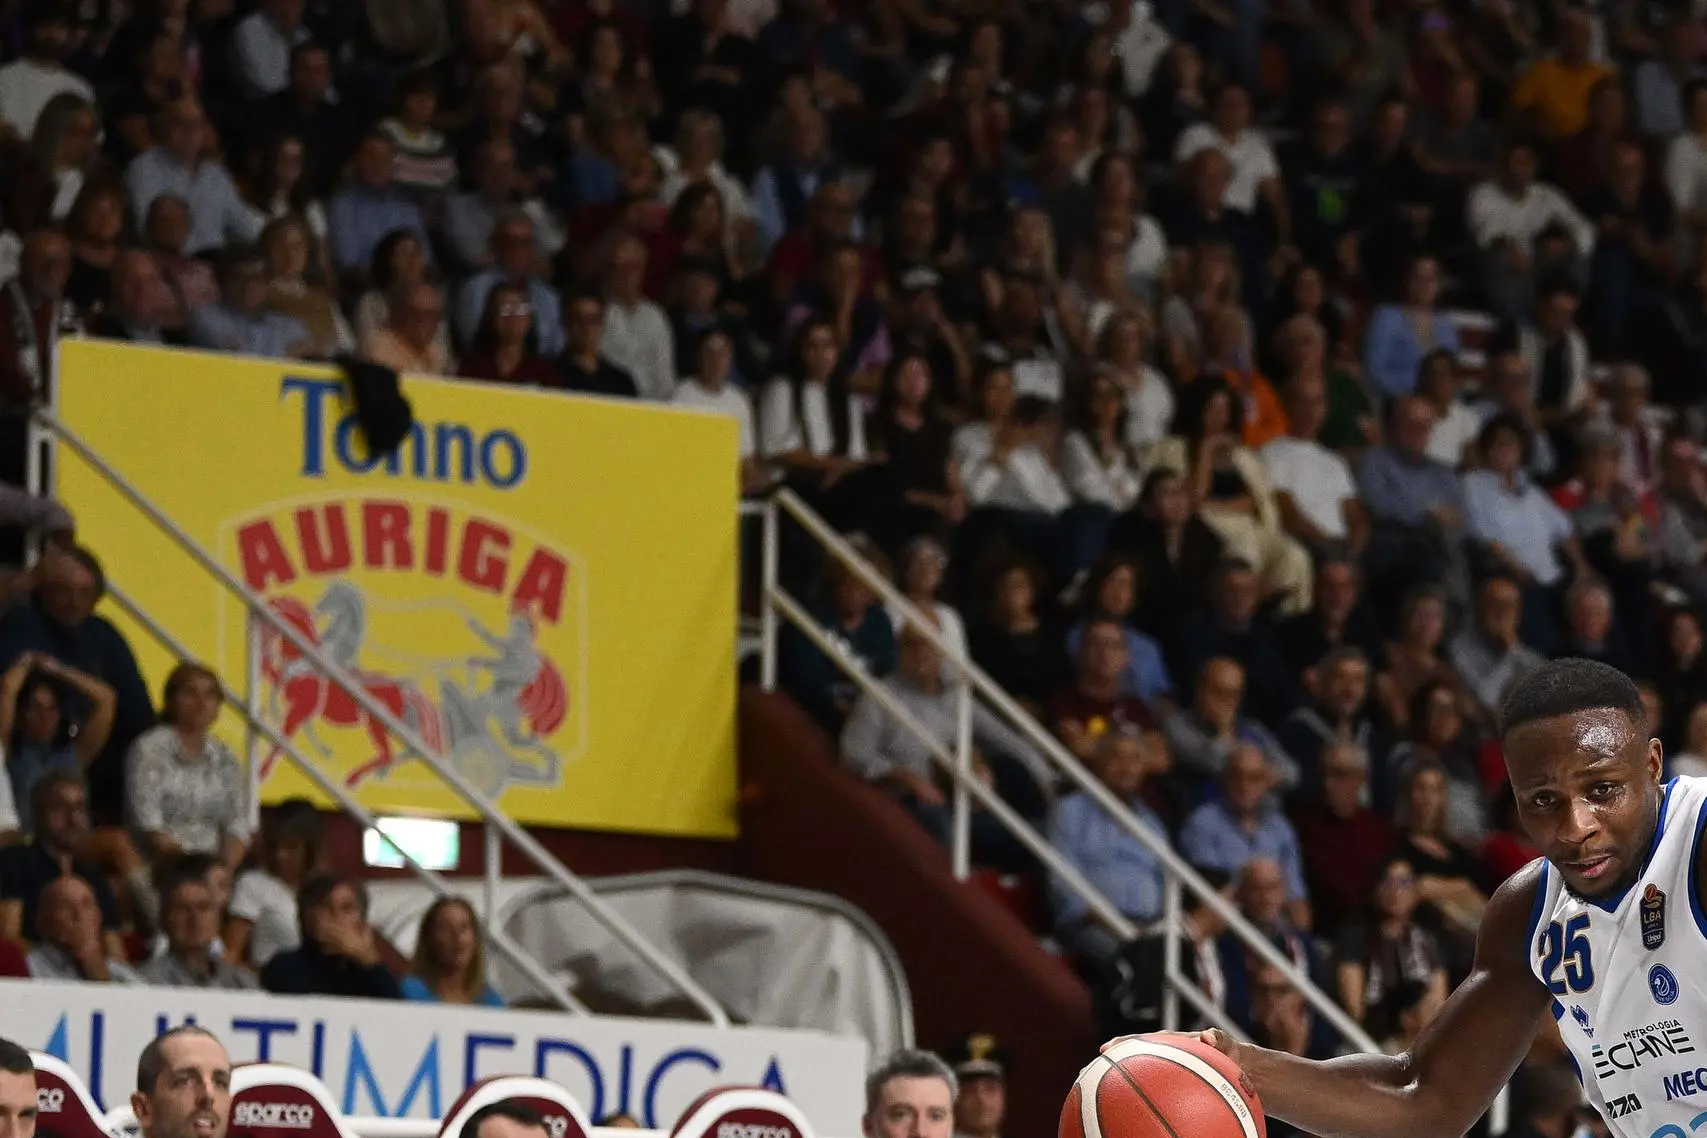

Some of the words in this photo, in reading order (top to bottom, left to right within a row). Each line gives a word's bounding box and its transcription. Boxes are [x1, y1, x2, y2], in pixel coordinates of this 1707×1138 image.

[237, 500, 568, 626] AURIGA
[1643, 911, 1663, 924] LBA
[1538, 911, 1596, 997] 25
[1623, 1018, 1682, 1040] METROLOGIA
[1592, 1027, 1696, 1079] ECHNE
[233, 1101, 313, 1129] sparco
